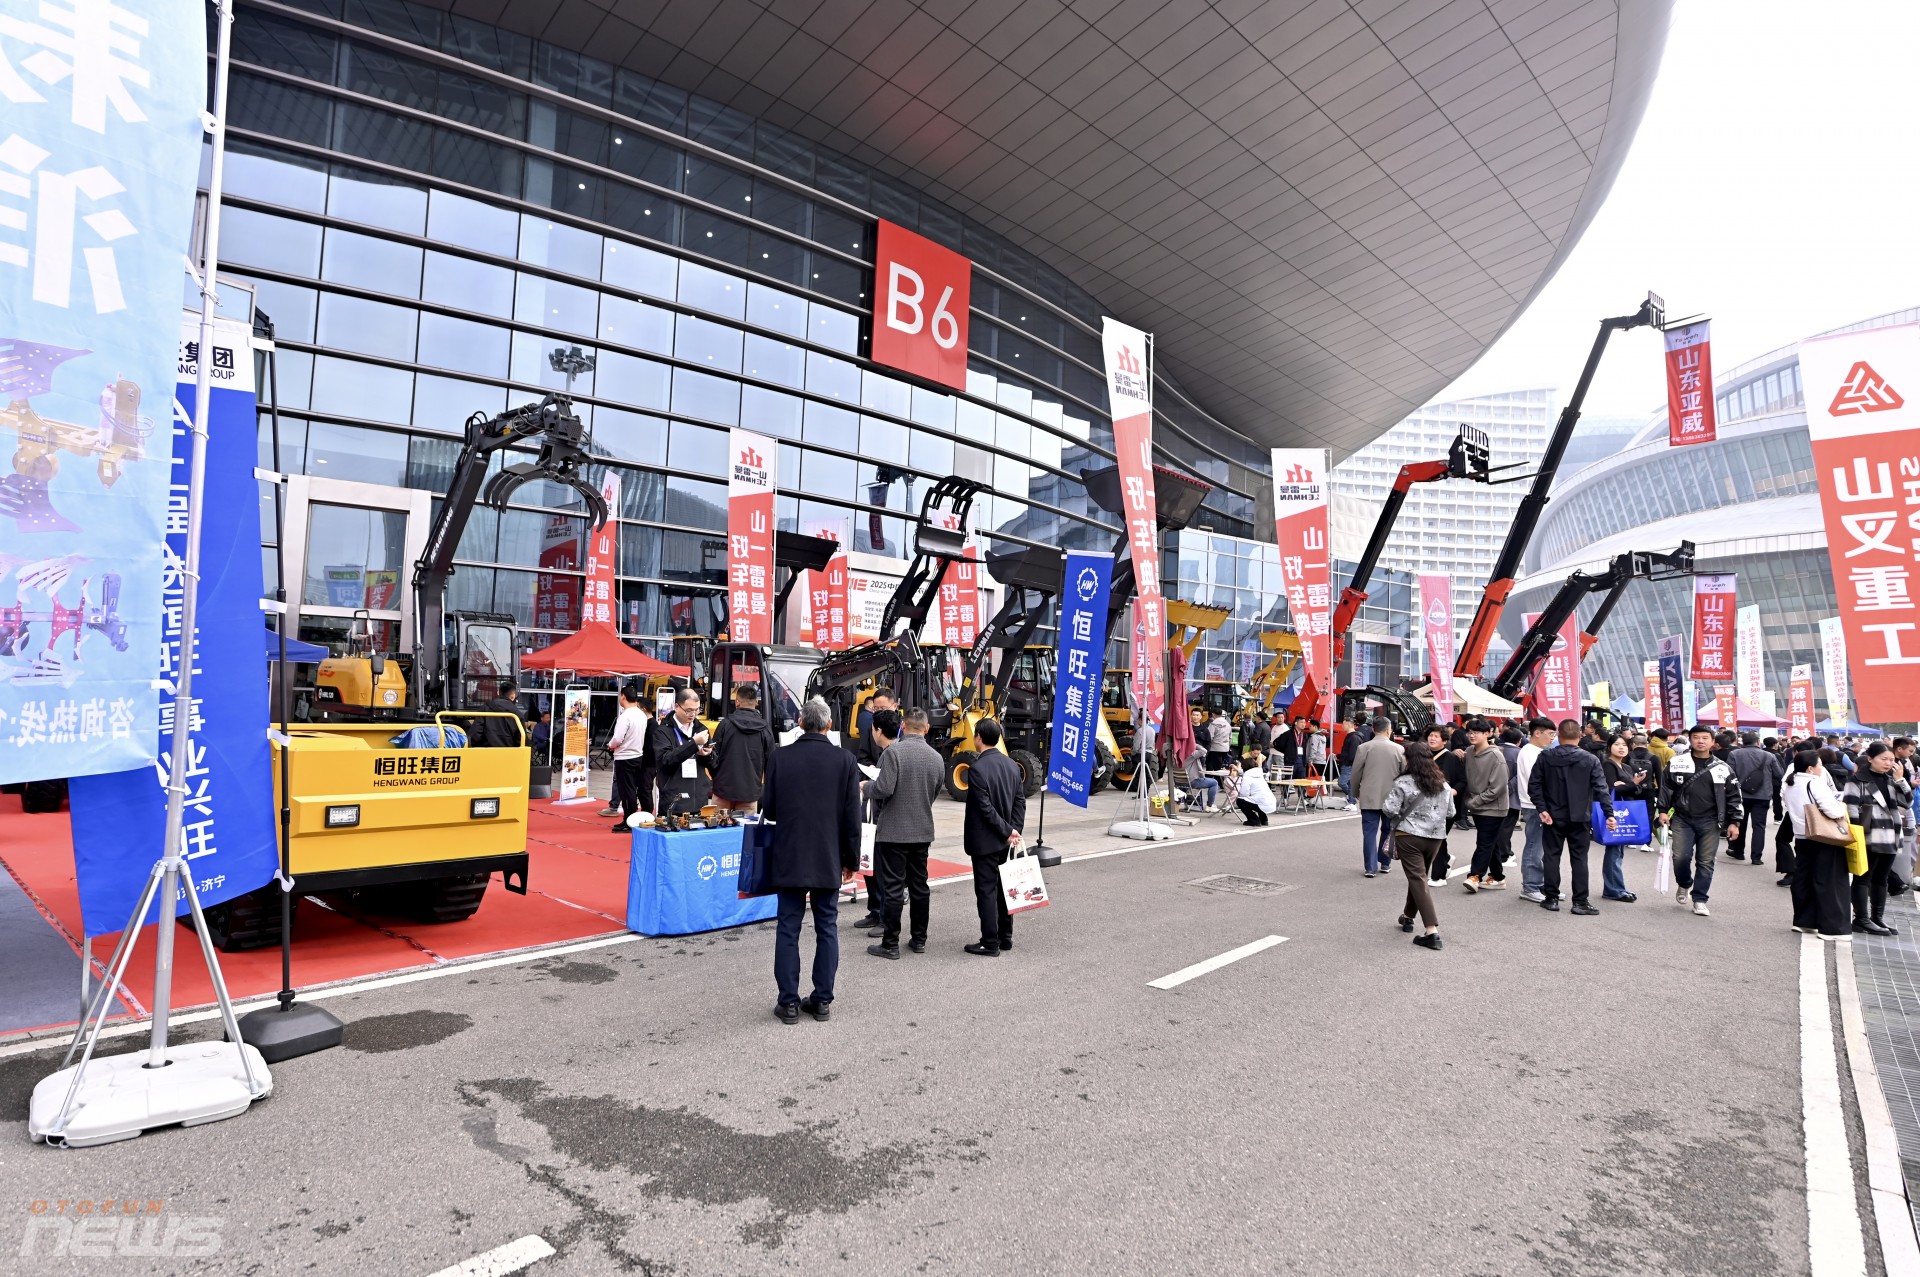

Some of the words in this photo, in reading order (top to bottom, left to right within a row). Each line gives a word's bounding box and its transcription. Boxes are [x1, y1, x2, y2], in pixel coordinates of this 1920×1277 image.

[887, 261, 958, 349] B6
[178, 341, 234, 370] 集团
[1678, 349, 1705, 434] 山东亚威
[970, 623, 996, 664] LEHMAN
[1701, 595, 1724, 670] 山东亚威
[1061, 609, 1094, 758] 恒旺集团
[1083, 673, 1096, 727] HENGWANG
[1666, 660, 1683, 734] YAWEH
[374, 756, 461, 776] 恒旺集团
[1081, 728, 1090, 762] GROUP
[373, 778, 427, 788] HENGWANG
[429, 777, 460, 785] GROUP
